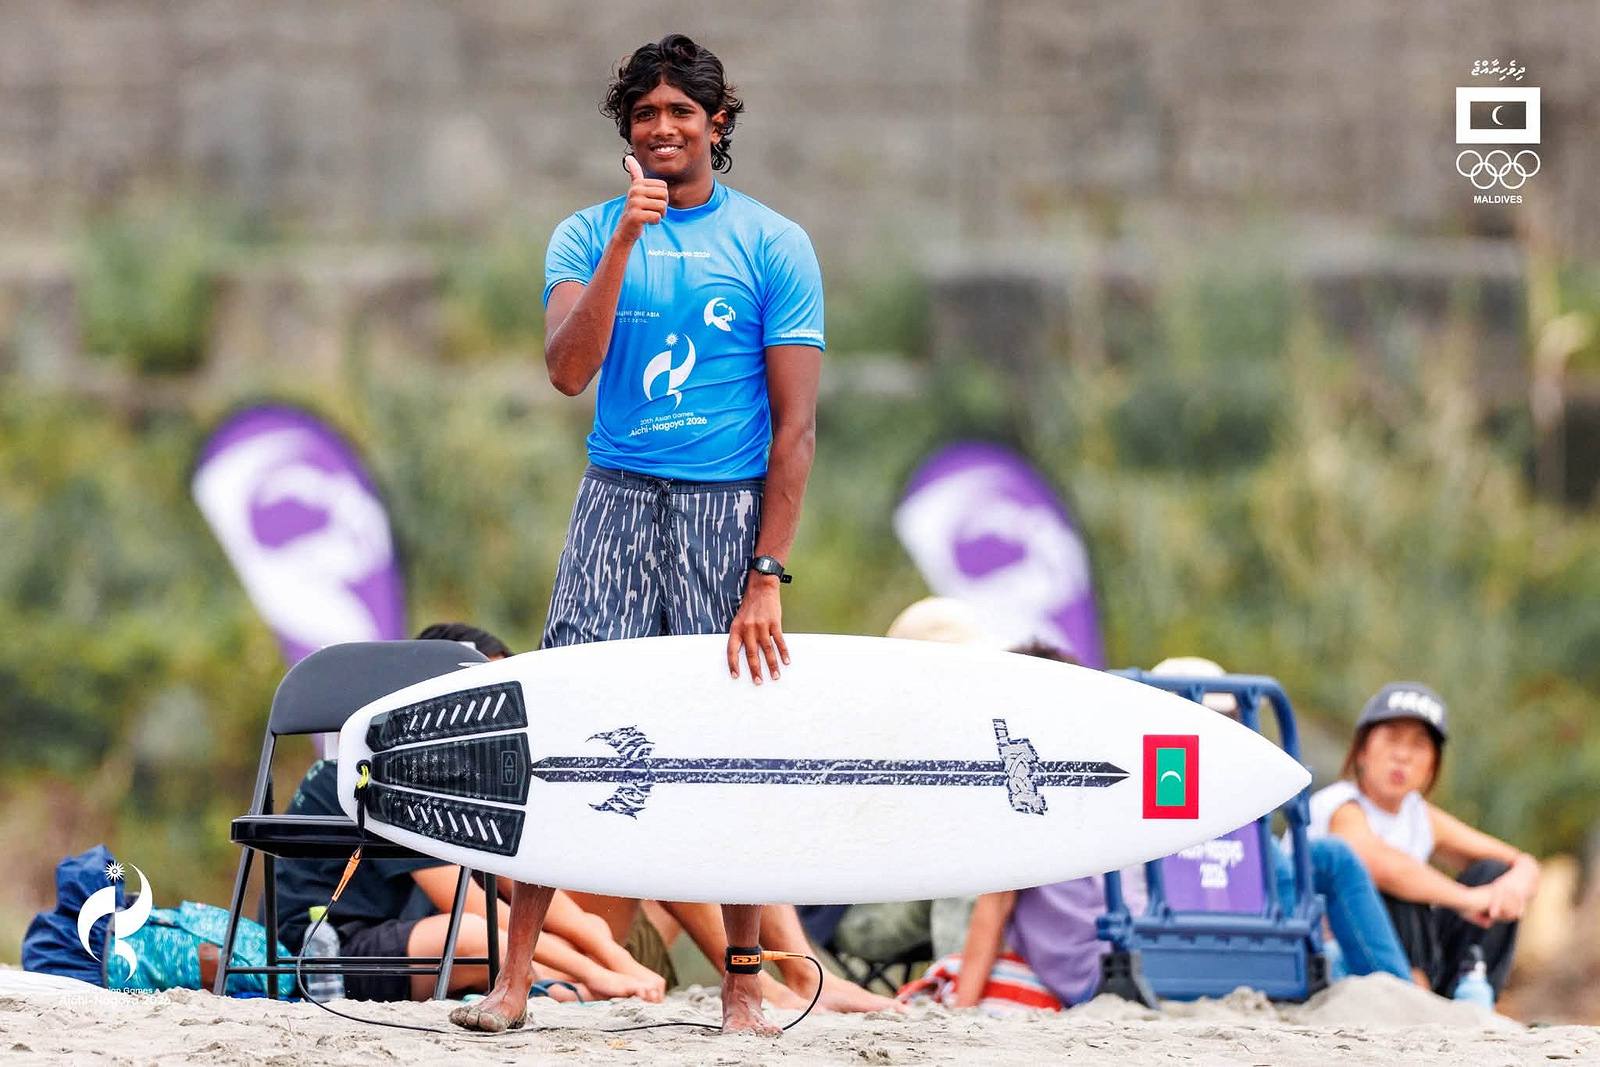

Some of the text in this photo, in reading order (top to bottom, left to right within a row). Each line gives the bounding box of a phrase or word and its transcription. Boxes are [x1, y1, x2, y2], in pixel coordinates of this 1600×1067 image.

[628, 416, 708, 437] Aichi-Nagoya 2026
[640, 411, 694, 426] 20th Asian Games
